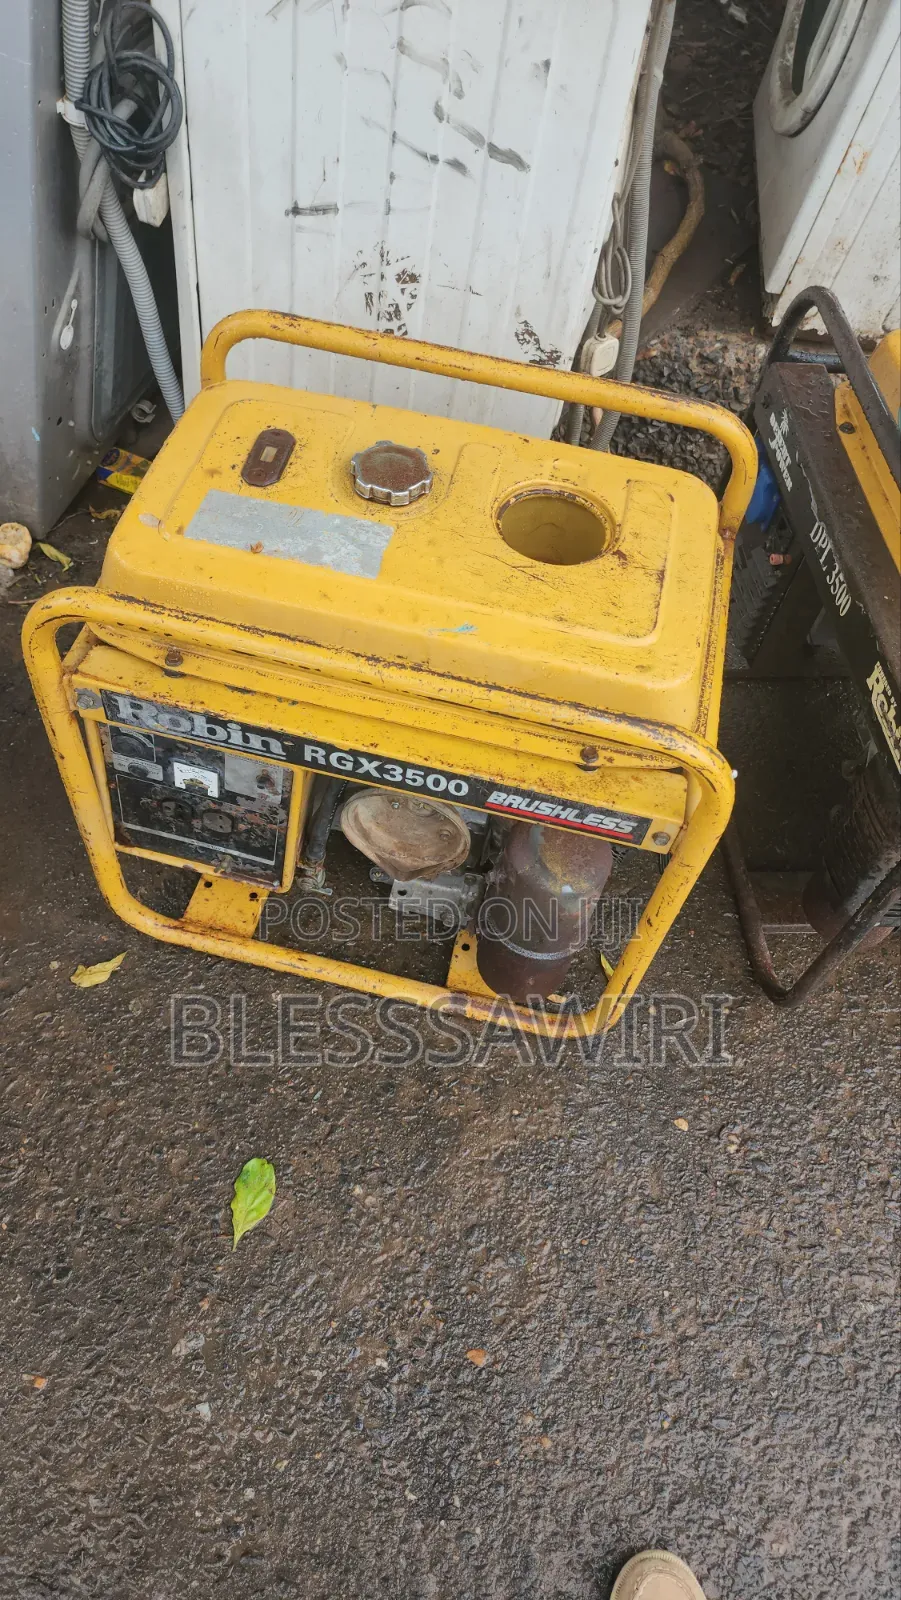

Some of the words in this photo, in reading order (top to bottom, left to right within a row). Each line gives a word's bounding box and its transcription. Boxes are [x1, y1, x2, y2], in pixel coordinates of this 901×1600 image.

[826, 562, 851, 616] 3500
[110, 694, 287, 757] Robin
[304, 744, 469, 797] RGX3500
[486, 790, 638, 834] BRUSHLESS
